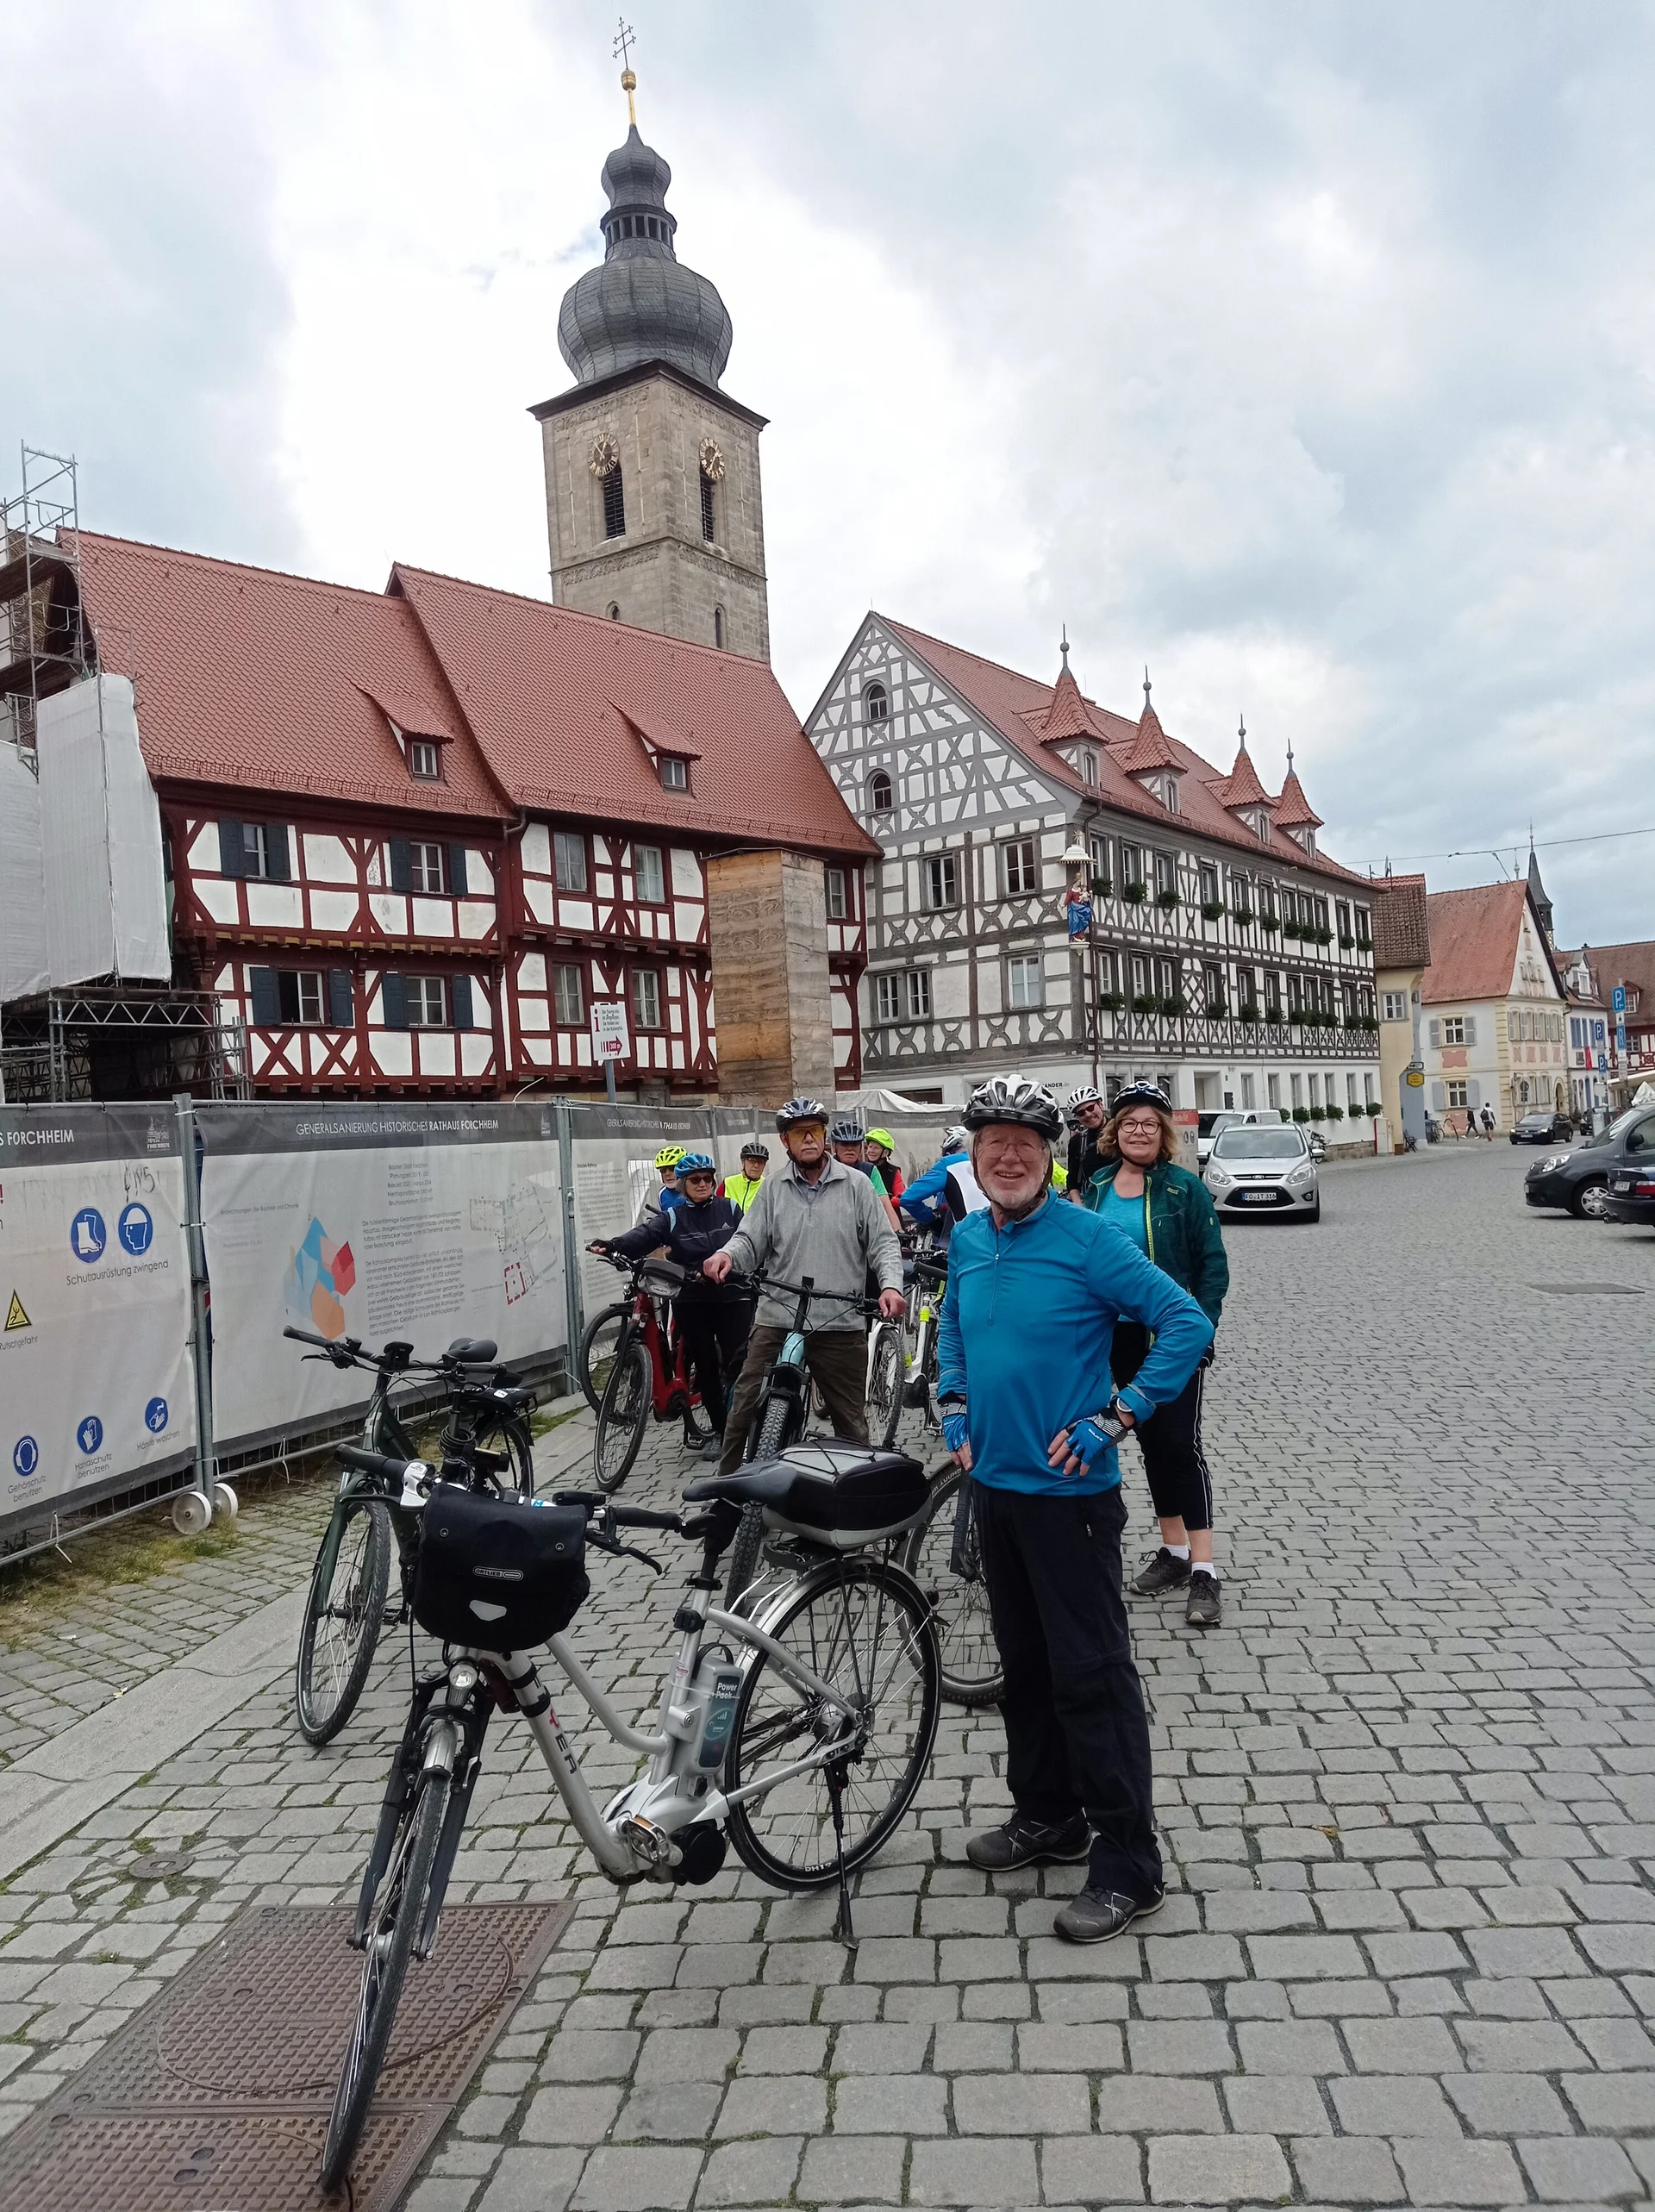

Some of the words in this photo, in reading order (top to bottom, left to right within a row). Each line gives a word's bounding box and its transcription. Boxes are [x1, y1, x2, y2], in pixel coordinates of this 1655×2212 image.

[1614, 990, 1621, 1009] P
[1596, 1024, 1602, 1038] P
[1599, 1056, 1604, 1068] P
[296, 1122, 378, 1135] GENERALSANIERUNG
[379, 1121, 429, 1133] HISTORISCHES
[429, 1120, 460, 1132] RATHAUS
[461, 1120, 499, 1130] FORCHHEIM
[7, 1128, 74, 1146] FORCHHEIM
[66, 1265, 132, 1286] Schutzausrüstung
[133, 1259, 169, 1275] zwingend
[74, 1453, 112, 1471] Handschutz
[78, 1463, 110, 1479] benutzen
[7, 1475, 47, 1495] Gehörschutz
[13, 1486, 43, 1503] benutzen
[474, 1568, 503, 1578] ORTLIEB
[717, 1682, 737, 1691] Power
